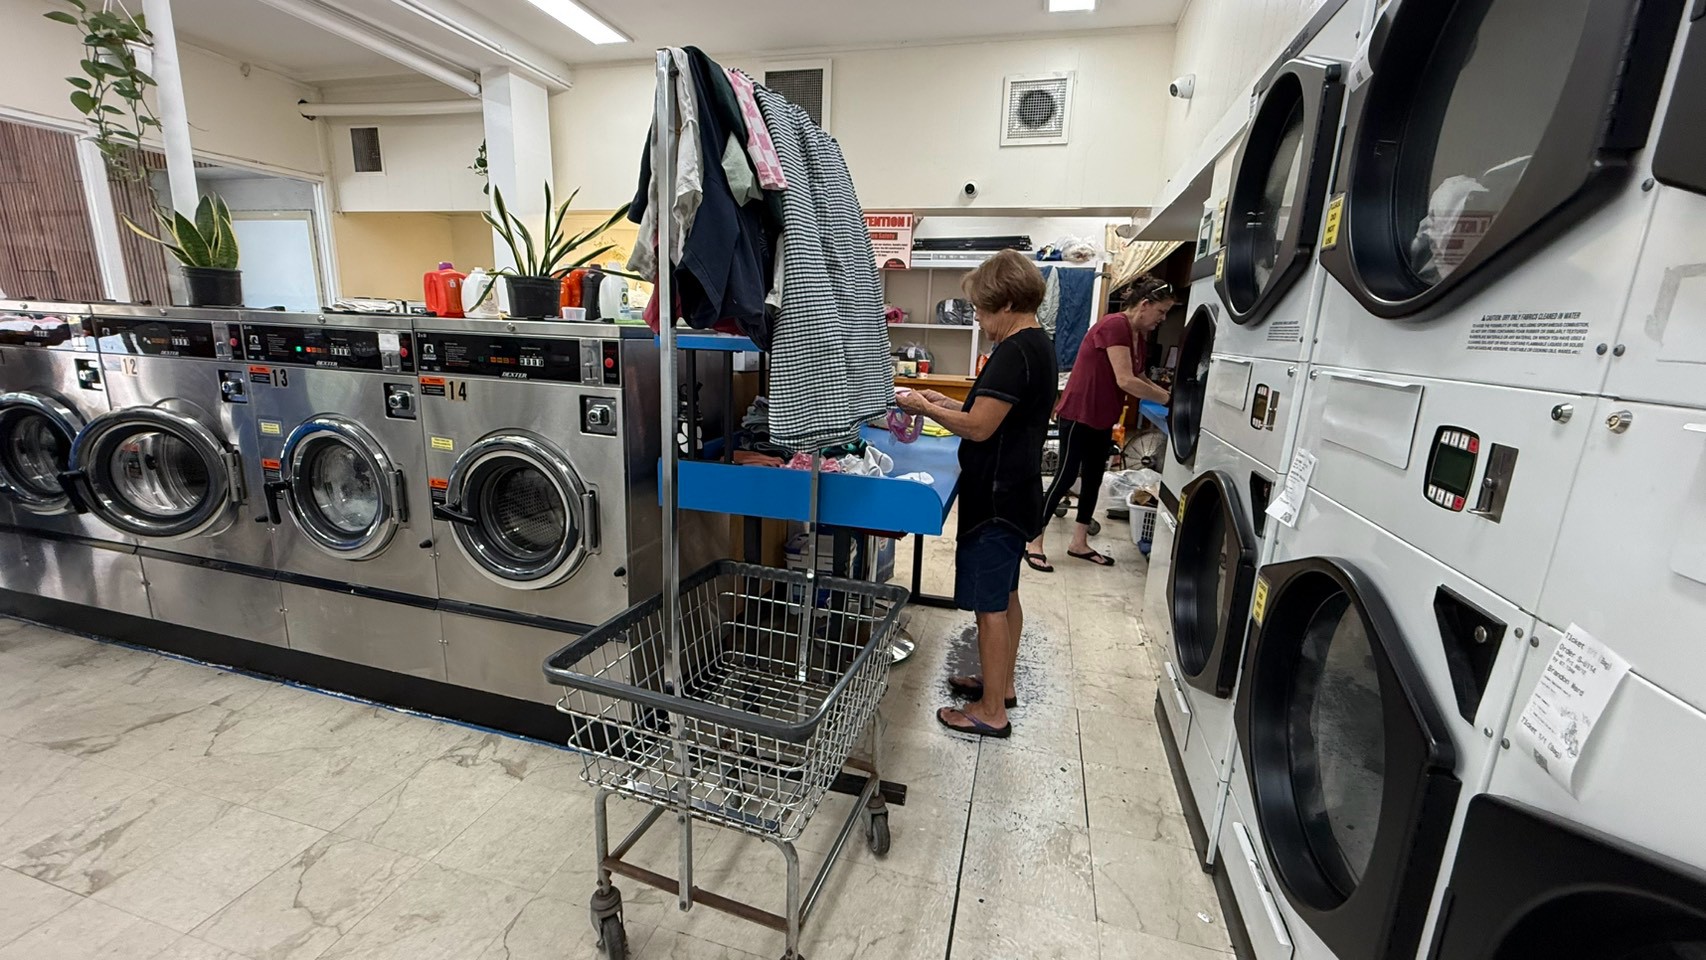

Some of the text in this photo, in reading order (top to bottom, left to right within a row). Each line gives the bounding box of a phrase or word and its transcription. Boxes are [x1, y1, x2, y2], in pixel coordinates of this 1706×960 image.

[864, 216, 905, 227] TENTION
[1538, 312, 1558, 320] CLEANED
[1563, 311, 1581, 319] WATER
[122, 358, 137, 375] 12
[272, 368, 288, 387] 13
[449, 381, 467, 400] 14
[1559, 643, 1576, 657] Order
[1565, 632, 1585, 650] Ticket
[1547, 664, 1570, 685] Brandon
[1571, 682, 1585, 697] Ward
[1521, 716, 1537, 735] Ticket
